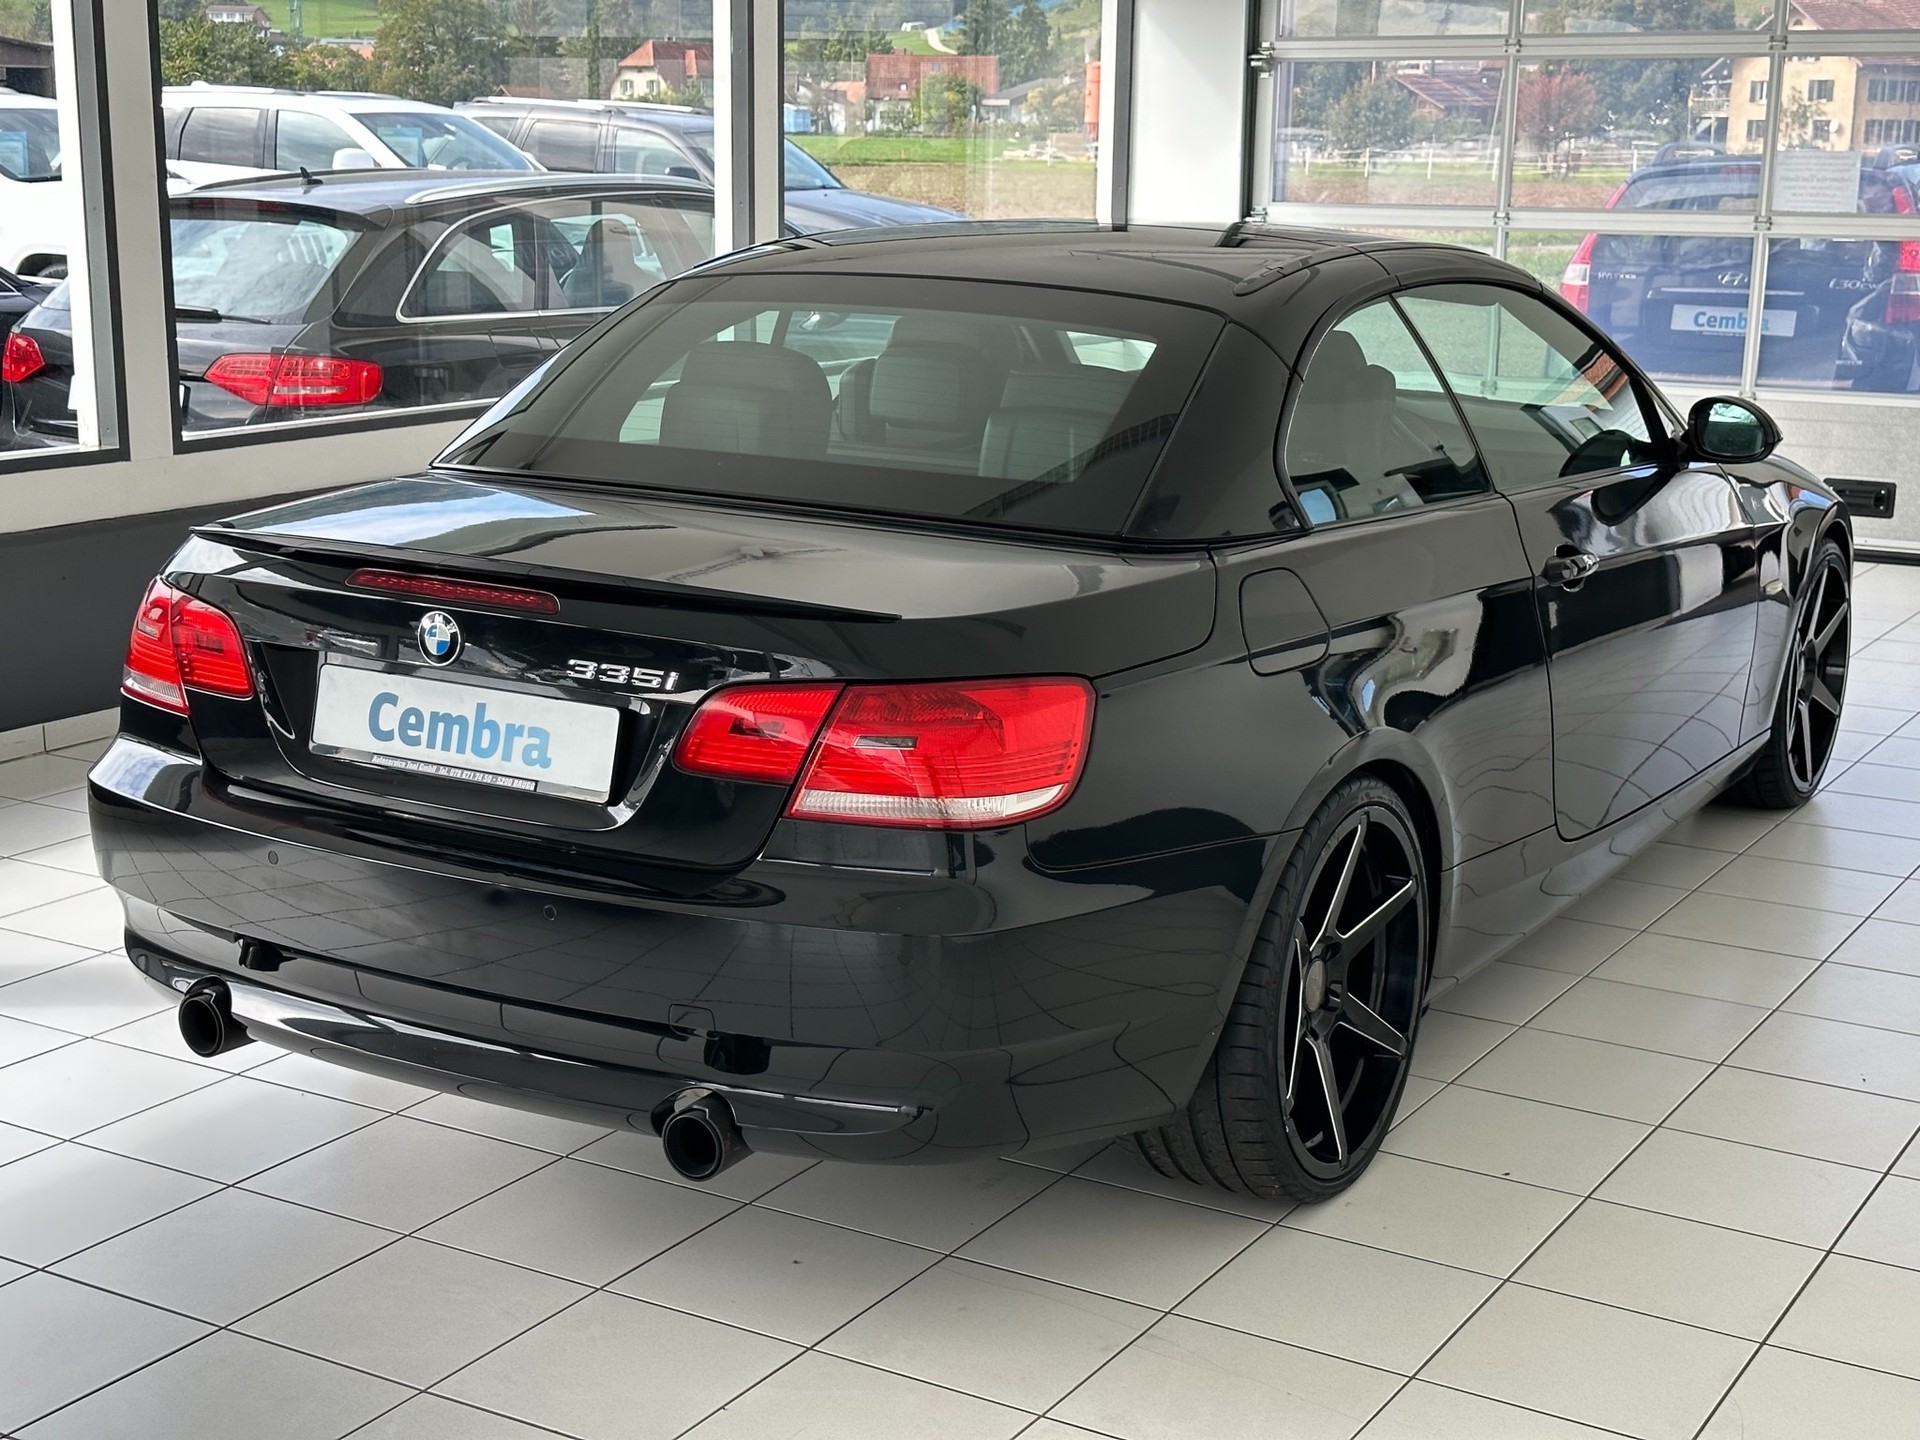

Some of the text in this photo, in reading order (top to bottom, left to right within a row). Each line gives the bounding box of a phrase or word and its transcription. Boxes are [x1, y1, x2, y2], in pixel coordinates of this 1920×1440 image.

[422, 614, 457, 634] BMW
[566, 659, 680, 691] 335i
[368, 691, 552, 769] Cembra
